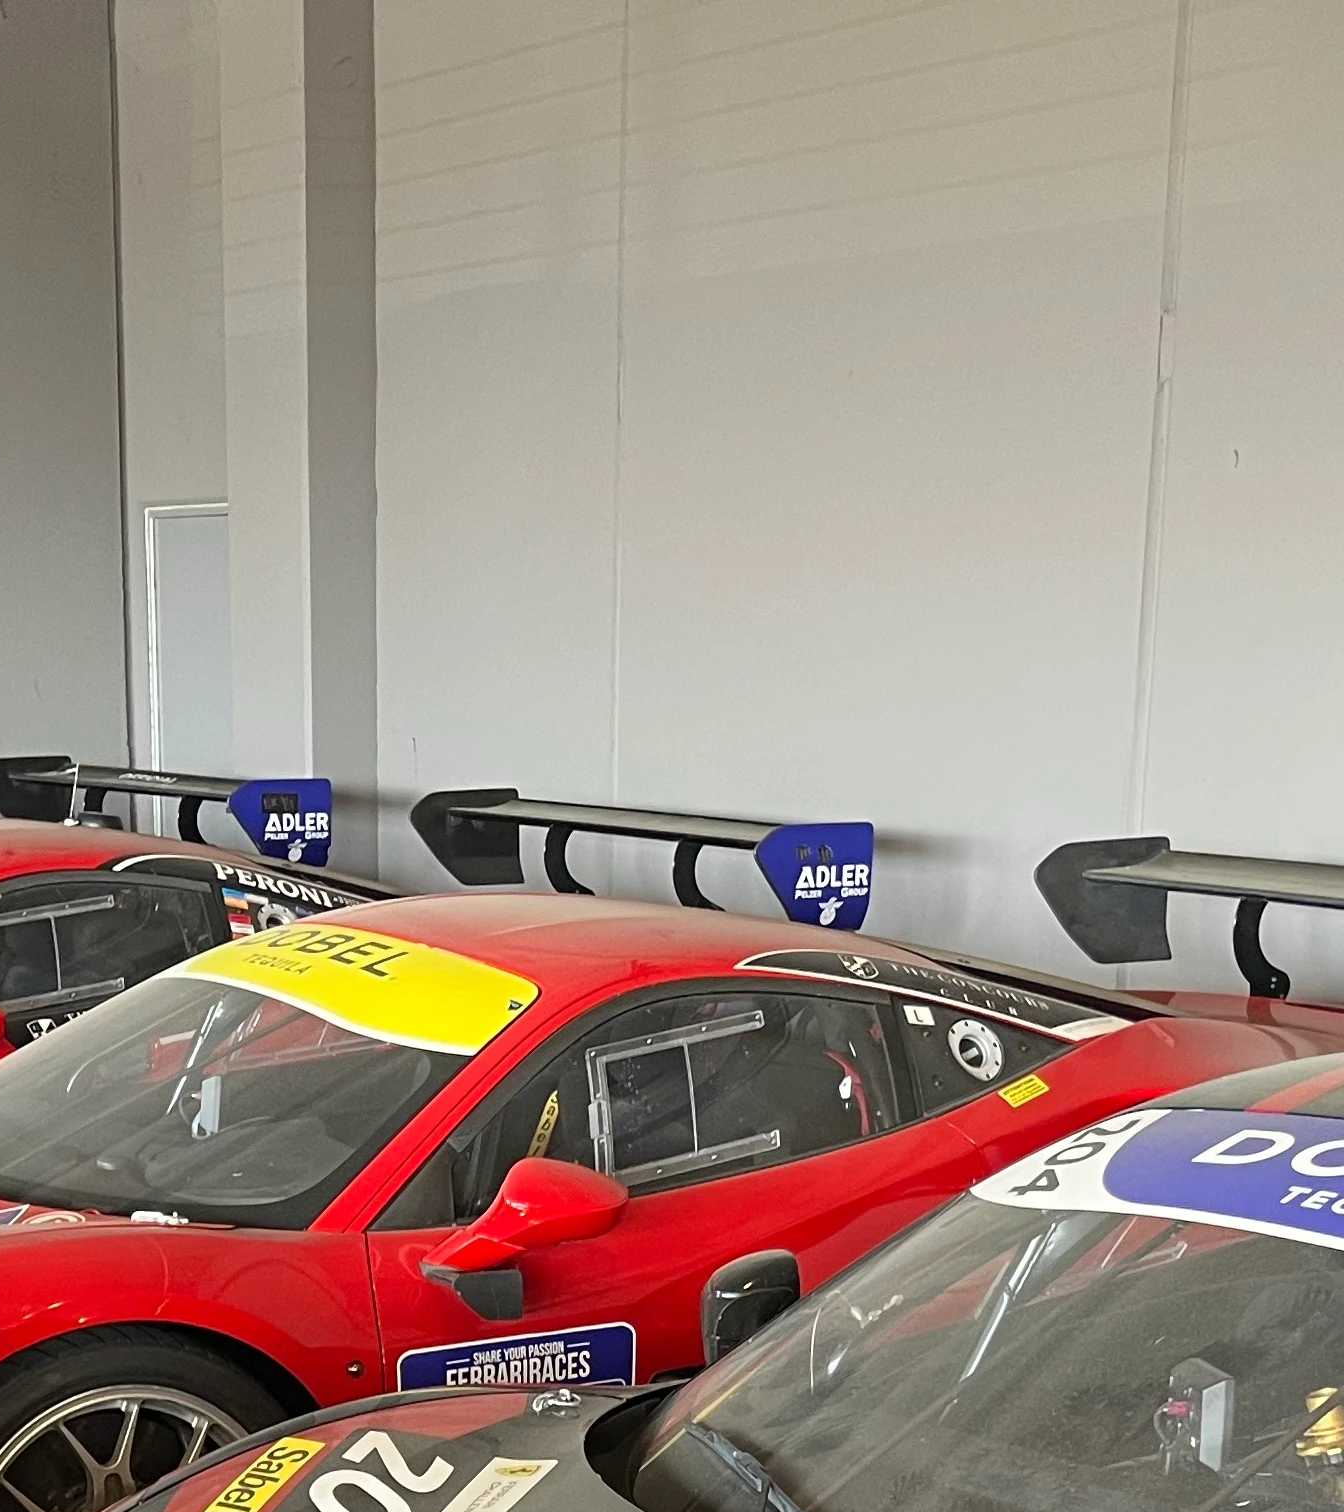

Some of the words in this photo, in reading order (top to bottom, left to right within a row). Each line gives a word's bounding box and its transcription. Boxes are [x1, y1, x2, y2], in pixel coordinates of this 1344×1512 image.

[264, 812, 329, 832] ADLER
[212, 861, 335, 908] PERONI
[795, 864, 870, 889] ADLER
[1006, 1118, 1142, 1197] 204
[472, 1349, 503, 1366] SHARE
[504, 1345, 527, 1362] YOUR
[528, 1340, 565, 1358] PASSION
